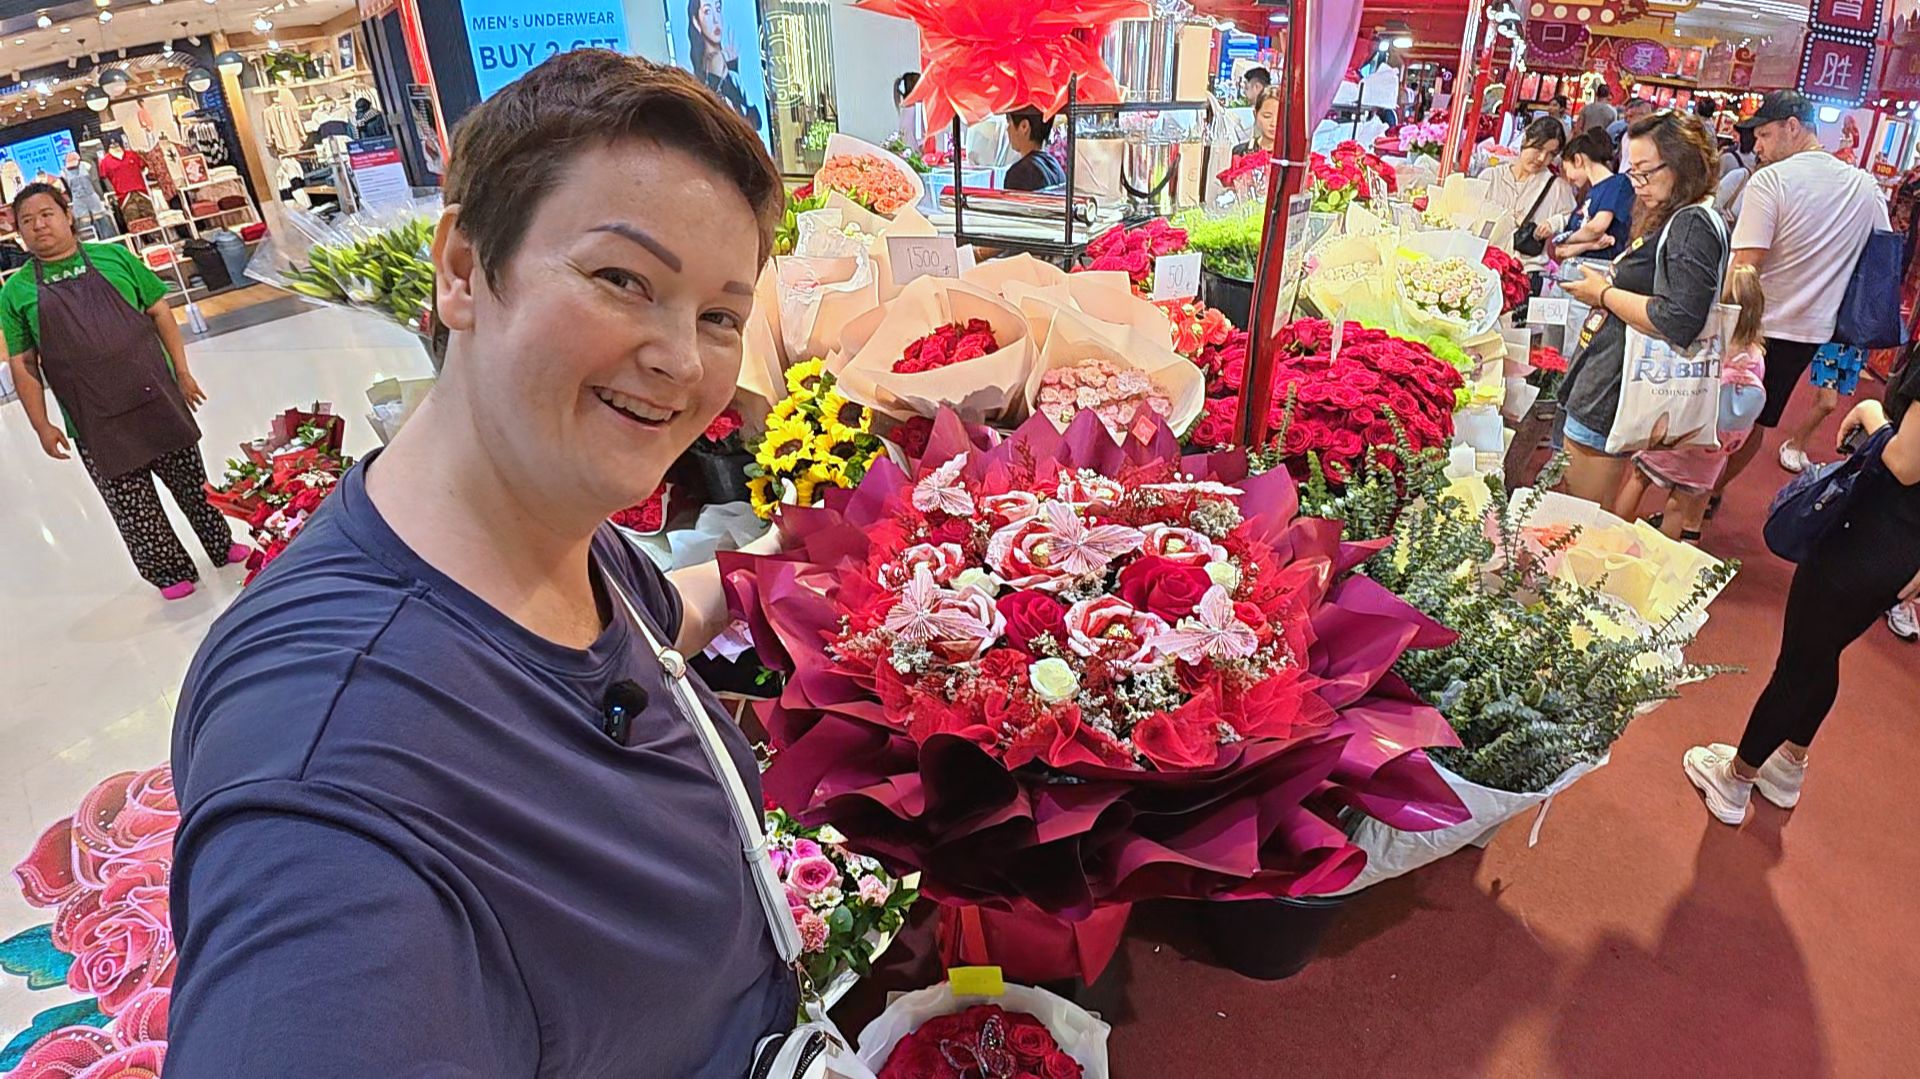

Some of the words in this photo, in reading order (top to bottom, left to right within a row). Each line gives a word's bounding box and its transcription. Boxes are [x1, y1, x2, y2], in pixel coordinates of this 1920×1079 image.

[472, 14, 518, 31] MEN's
[523, 11, 615, 28] UNDERWEAR
[478, 42, 537, 70] BUY
[1814, 51, 1853, 91] 胜
[906, 246, 940, 270] 1500
[1167, 264, 1184, 289] 50
